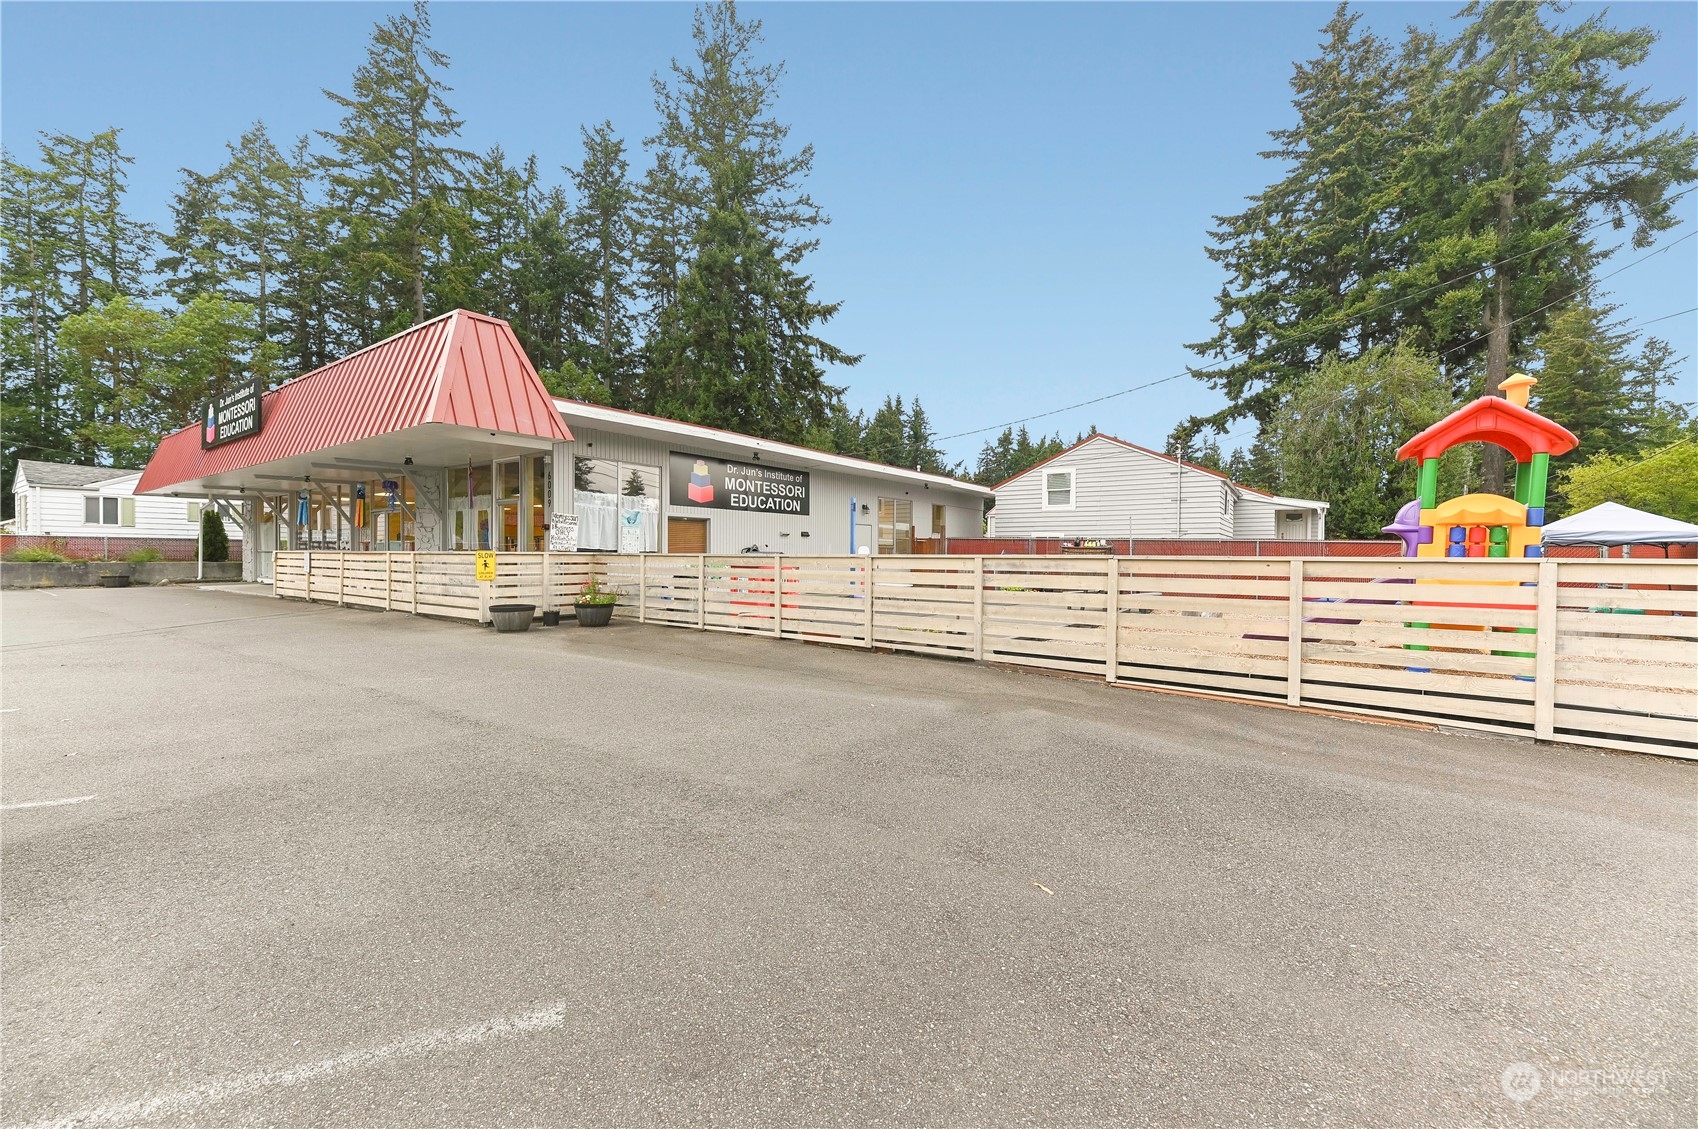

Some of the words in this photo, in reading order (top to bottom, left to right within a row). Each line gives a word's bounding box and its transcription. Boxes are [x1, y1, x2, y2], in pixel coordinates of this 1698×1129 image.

[224, 394, 234, 406] Jun's
[234, 387, 250, 401] Institute
[250, 382, 254, 394] of
[218, 397, 256, 425] MONTESSORI
[220, 415, 252, 440] EDUCATION
[727, 464, 738, 474] Dr.
[741, 466, 762, 478] Jun's
[764, 470, 794, 482] Institute
[796, 474, 802, 482] of
[724, 477, 805, 498] MONTESSORI
[730, 494, 800, 512] EDUCATION
